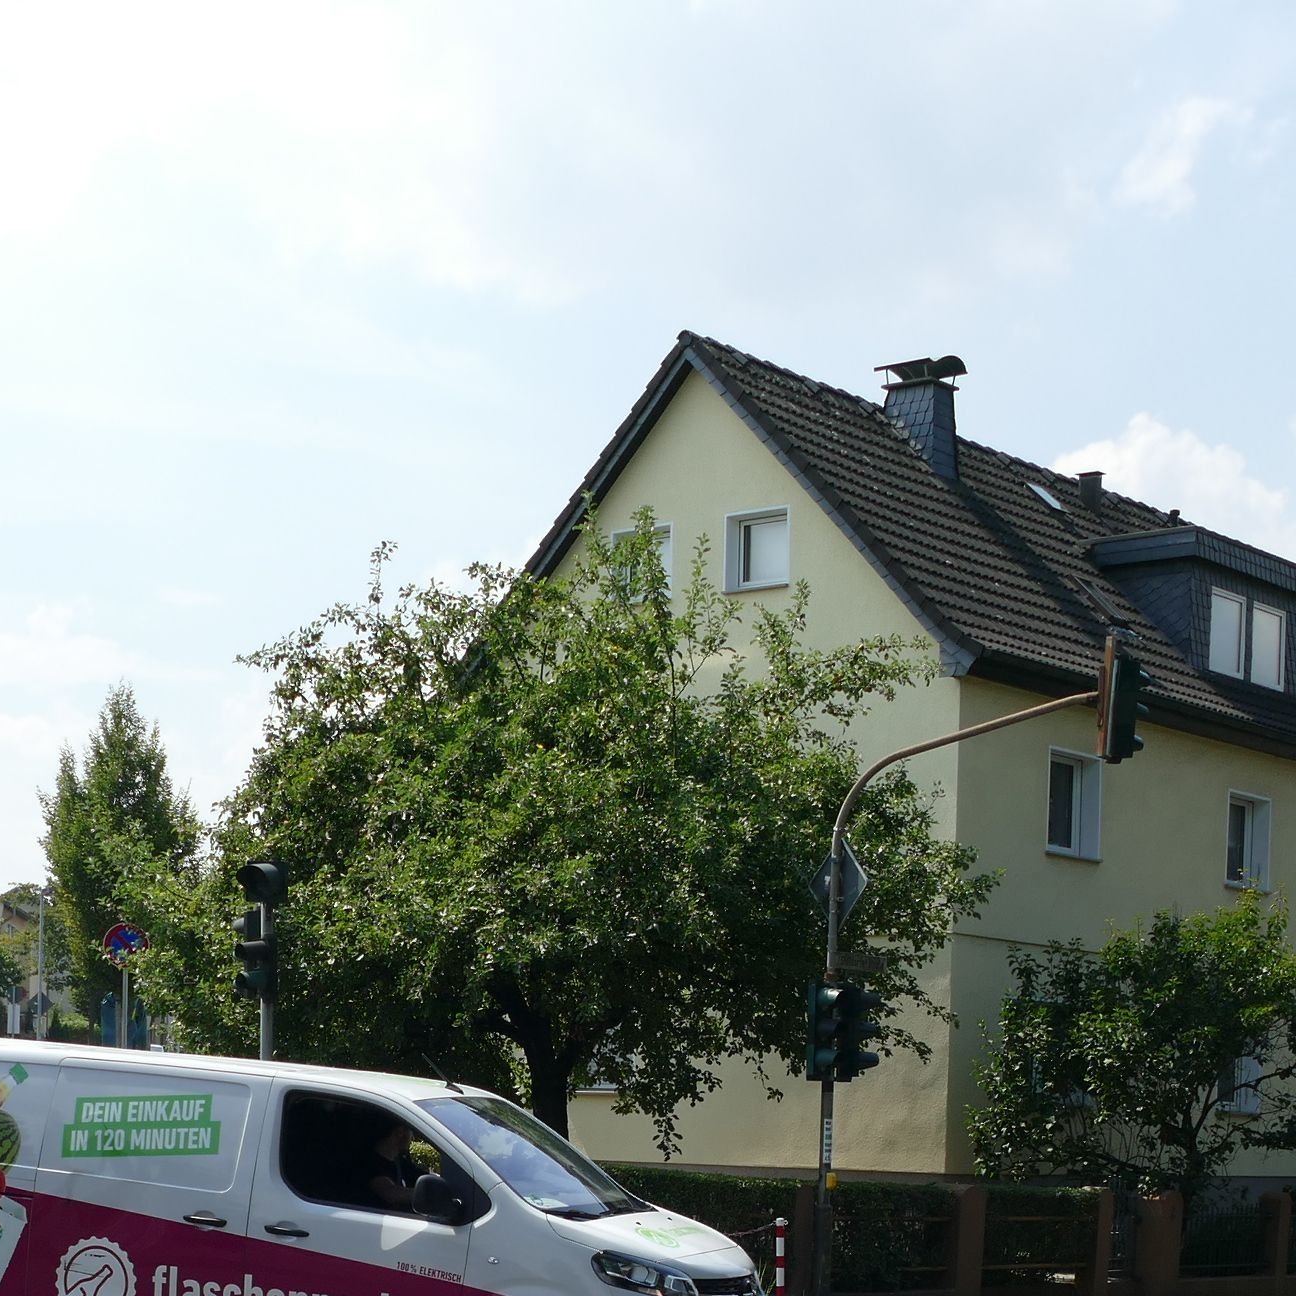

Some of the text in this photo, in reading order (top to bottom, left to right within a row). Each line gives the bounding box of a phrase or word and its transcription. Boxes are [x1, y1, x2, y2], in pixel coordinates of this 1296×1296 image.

[81, 1099, 206, 1123] DEIN EINKAUF
[70, 1127, 212, 1151] IN 120 MINUTEN
[419, 1266, 462, 1283] ELEKTRISCH
